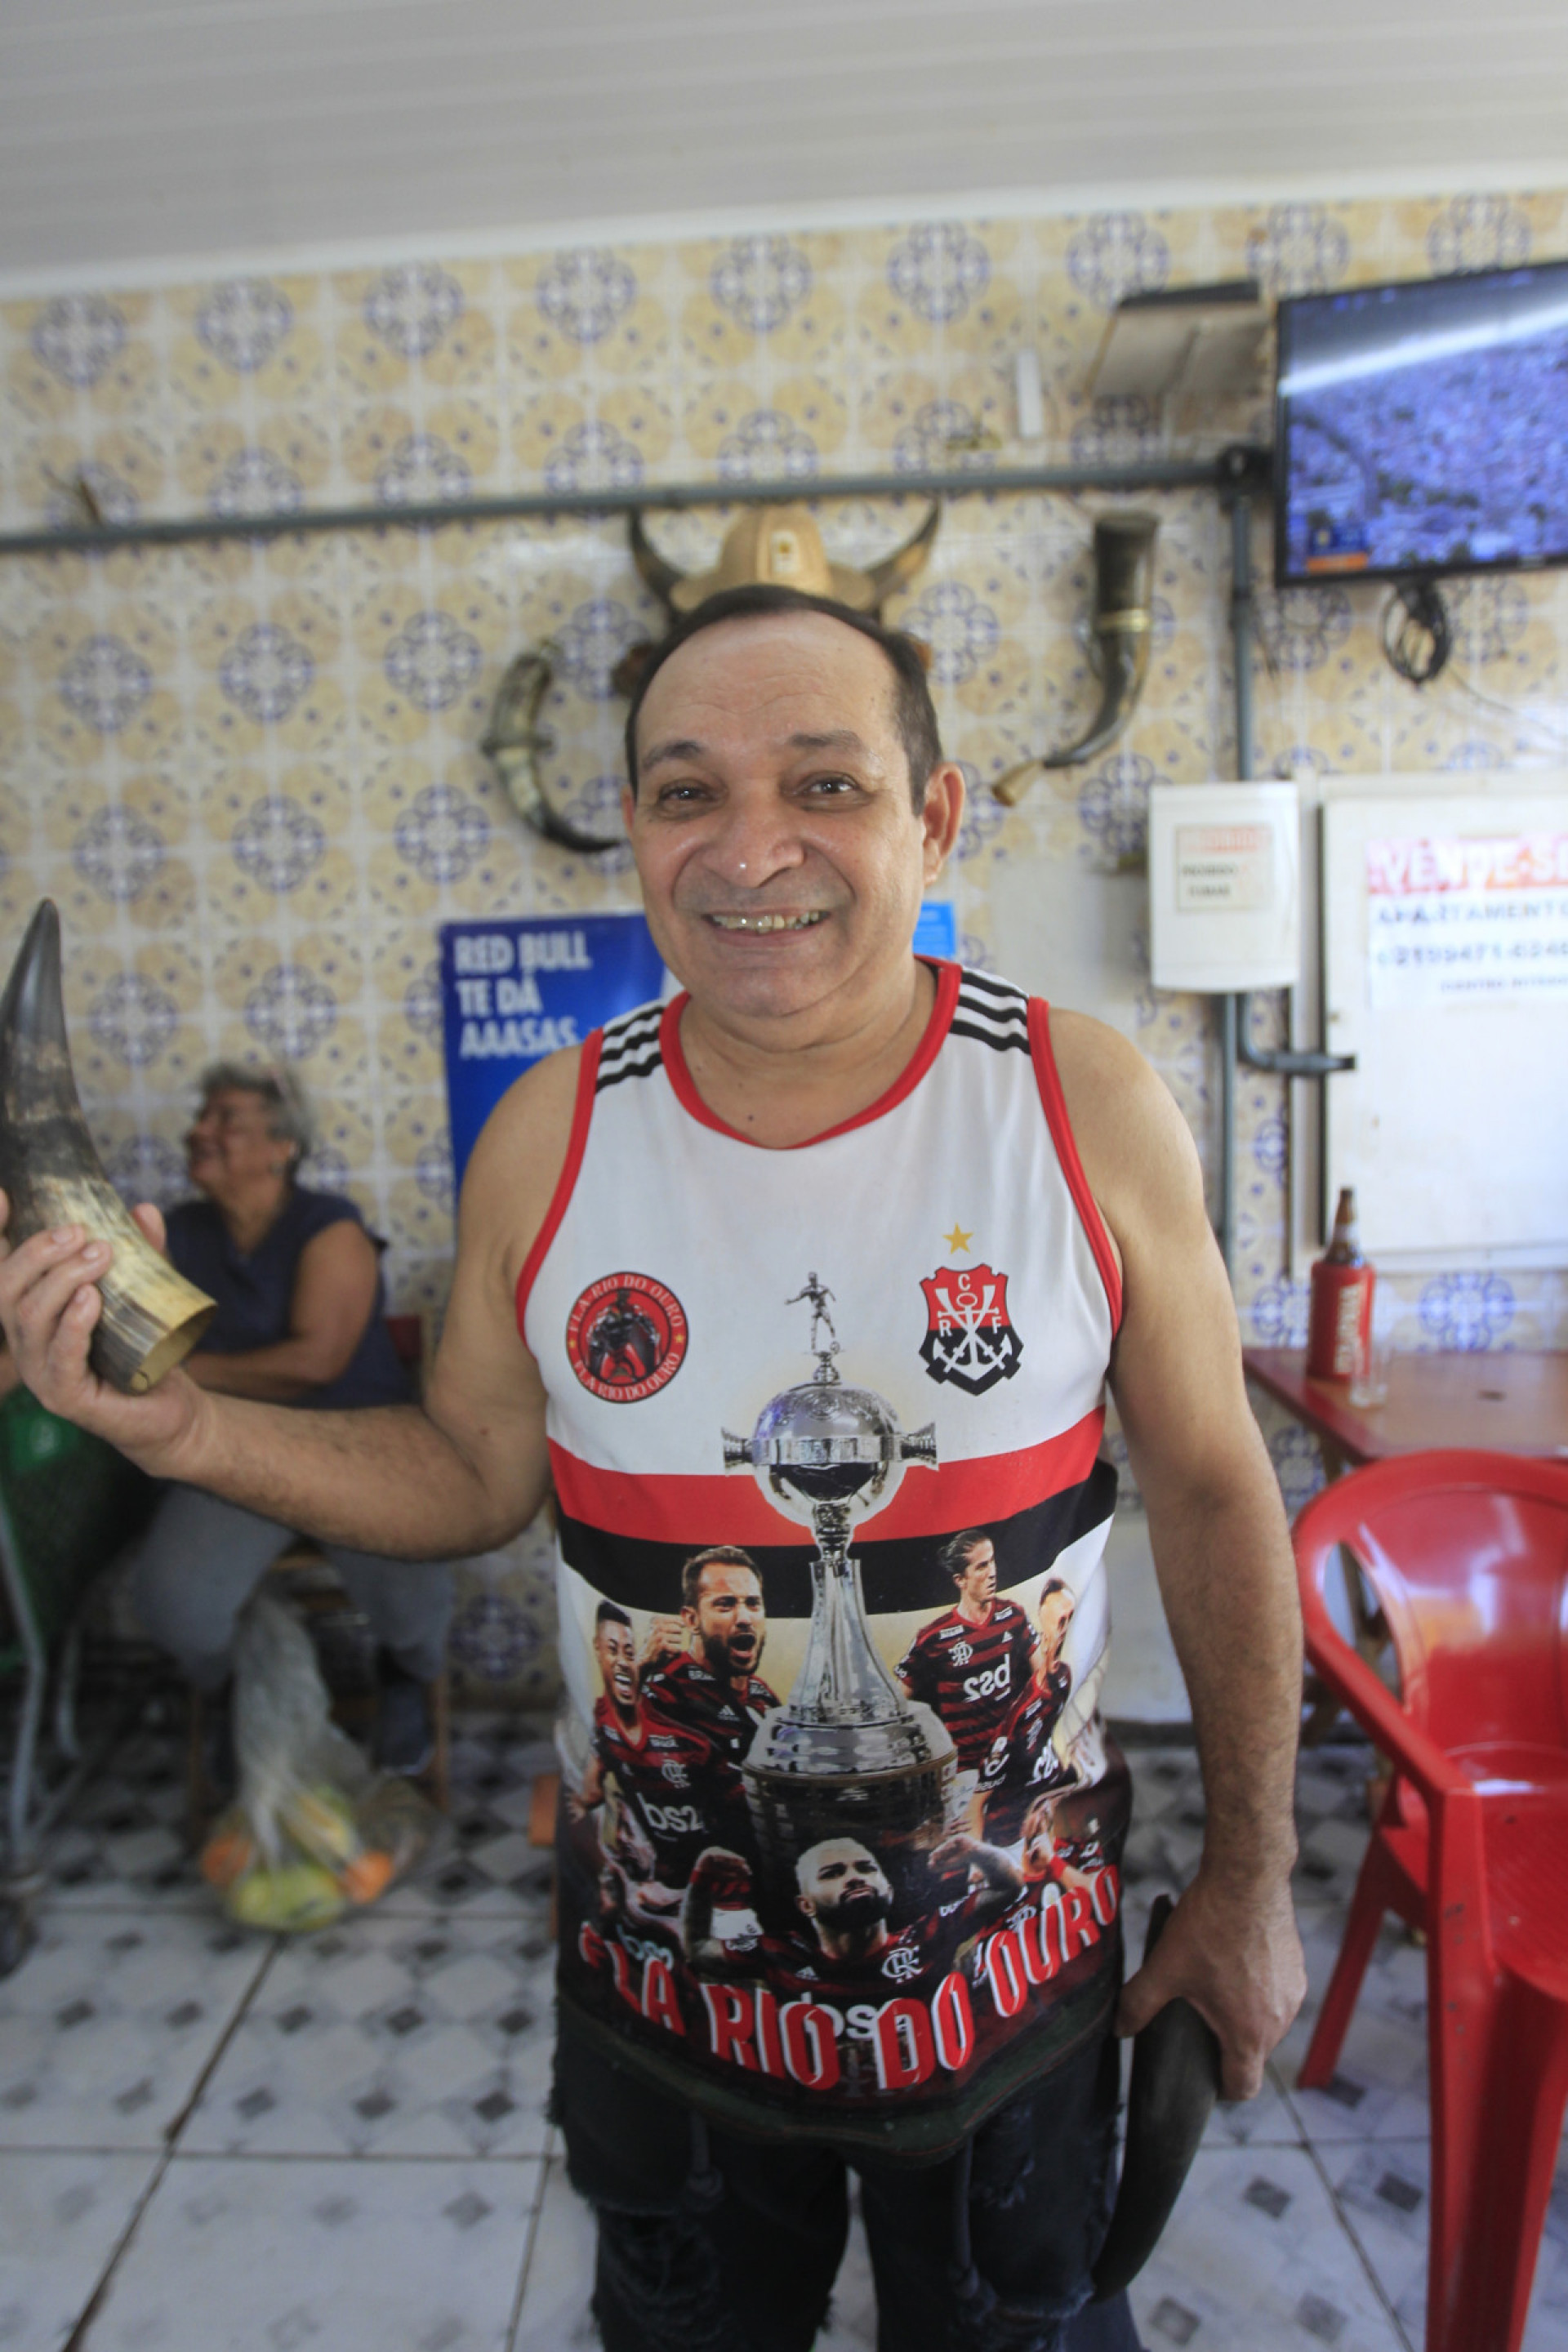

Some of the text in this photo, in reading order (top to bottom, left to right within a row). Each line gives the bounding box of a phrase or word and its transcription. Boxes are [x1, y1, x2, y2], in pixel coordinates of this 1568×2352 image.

[454, 930, 592, 975] RED BULL
[455, 978, 493, 1018] TE
[590, 1276, 618, 1298] RIO
[624, 1273, 648, 1290] DO
[649, 1284, 684, 1328] OURO
[958, 1273, 971, 1291] C
[626, 1384, 648, 1401] DO
[637, 1792, 705, 1833] bs2
[698, 1982, 841, 2091] RIO
[873, 1971, 976, 2091] DO
[985, 1864, 1119, 2018] OURO
